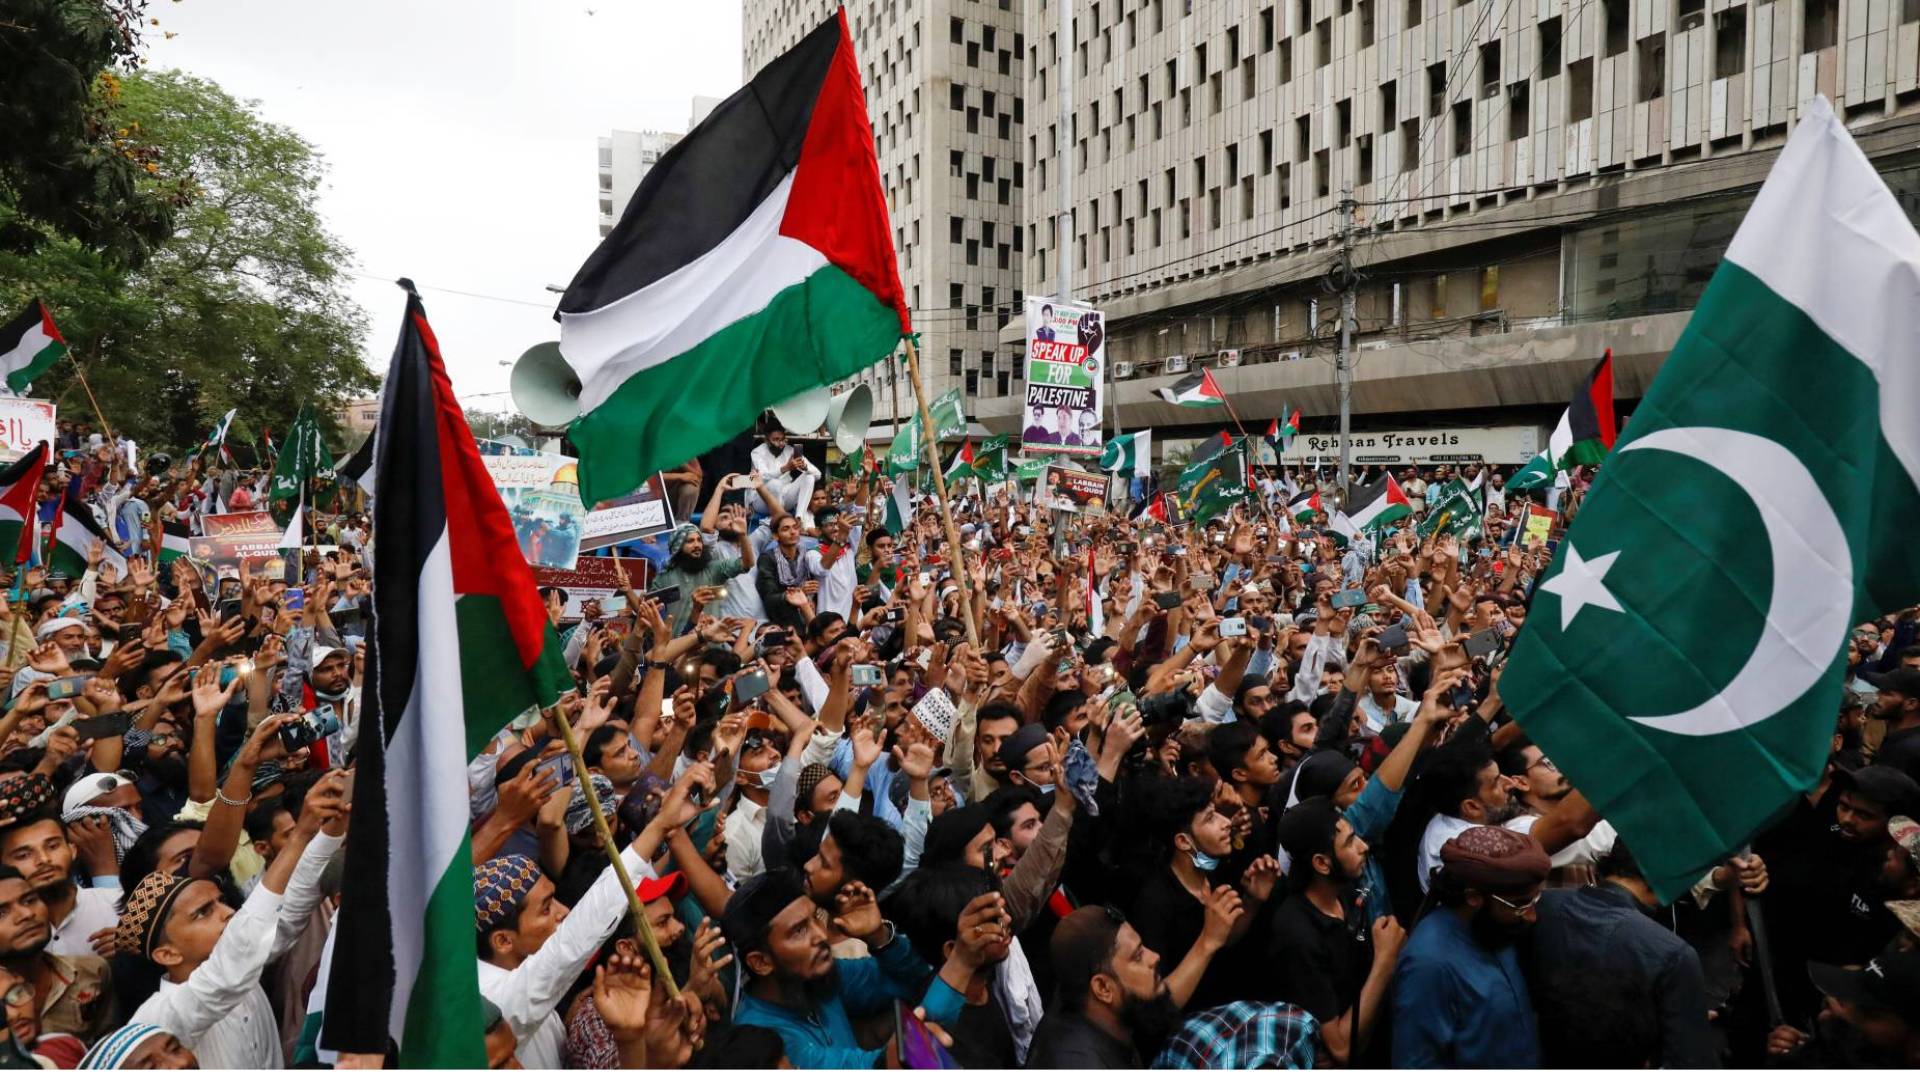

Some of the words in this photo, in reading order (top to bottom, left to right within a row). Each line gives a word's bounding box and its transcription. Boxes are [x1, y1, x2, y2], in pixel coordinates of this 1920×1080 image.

[1032, 341, 1067, 361] SPEAK
[1069, 346, 1085, 363] UP
[1047, 363, 1073, 384] FOR
[1028, 386, 1090, 407] PALESTINE
[1308, 437, 1376, 452] Rehan
[1383, 432, 1459, 448] Travels
[1072, 485, 1104, 495] AL-QUDS
